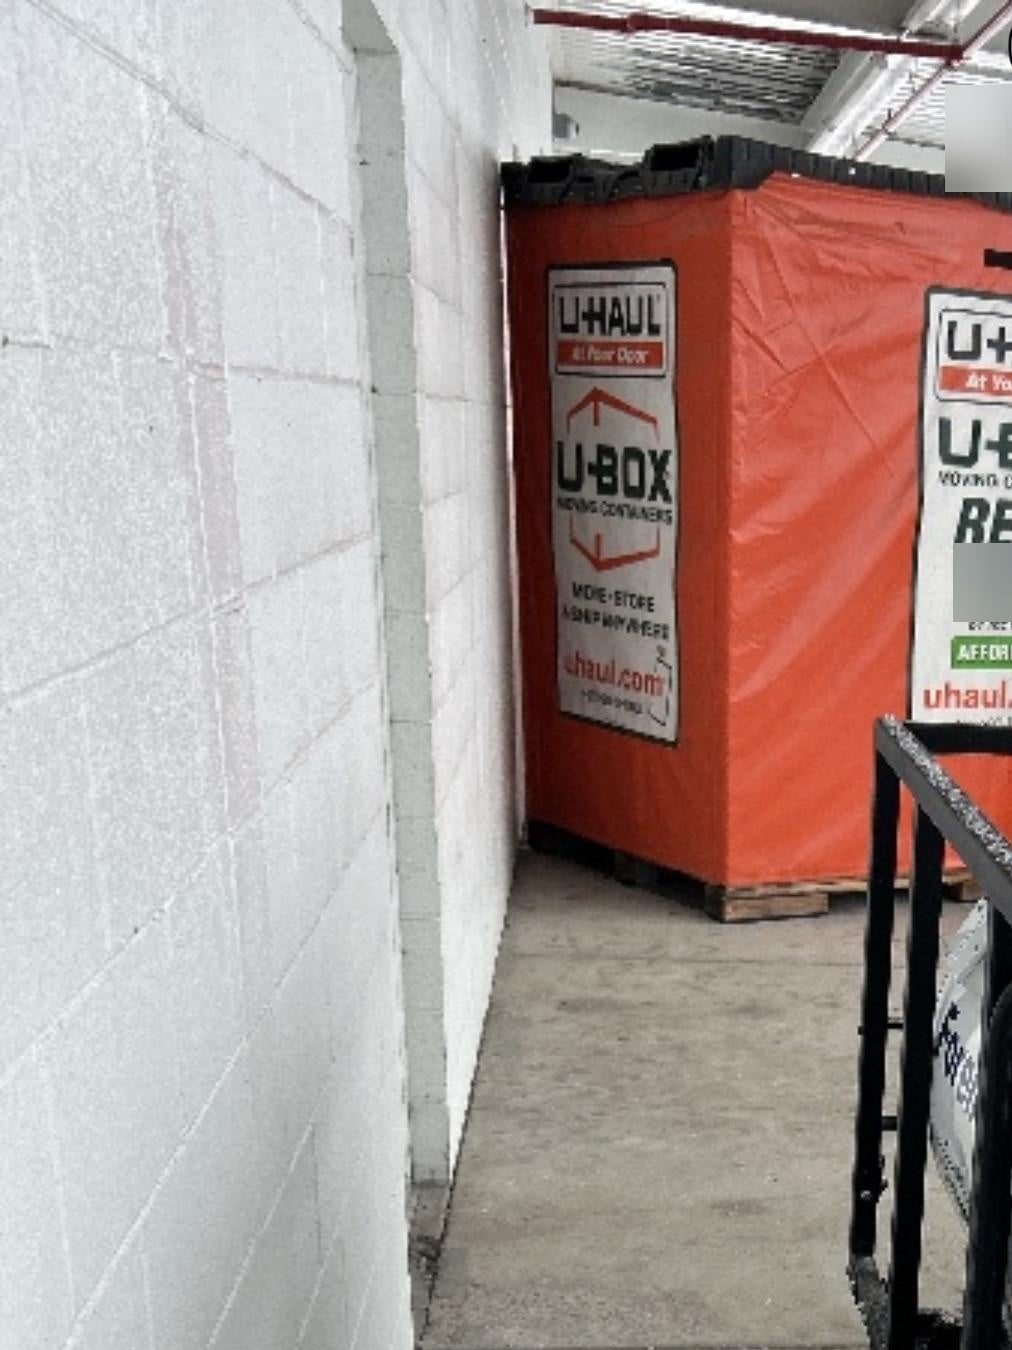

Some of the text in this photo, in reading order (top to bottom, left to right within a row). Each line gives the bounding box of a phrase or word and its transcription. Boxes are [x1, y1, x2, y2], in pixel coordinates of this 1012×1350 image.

[559, 294, 661, 336] U-HAUL
[965, 372, 988, 391] At
[556, 440, 672, 504] U-BOX
